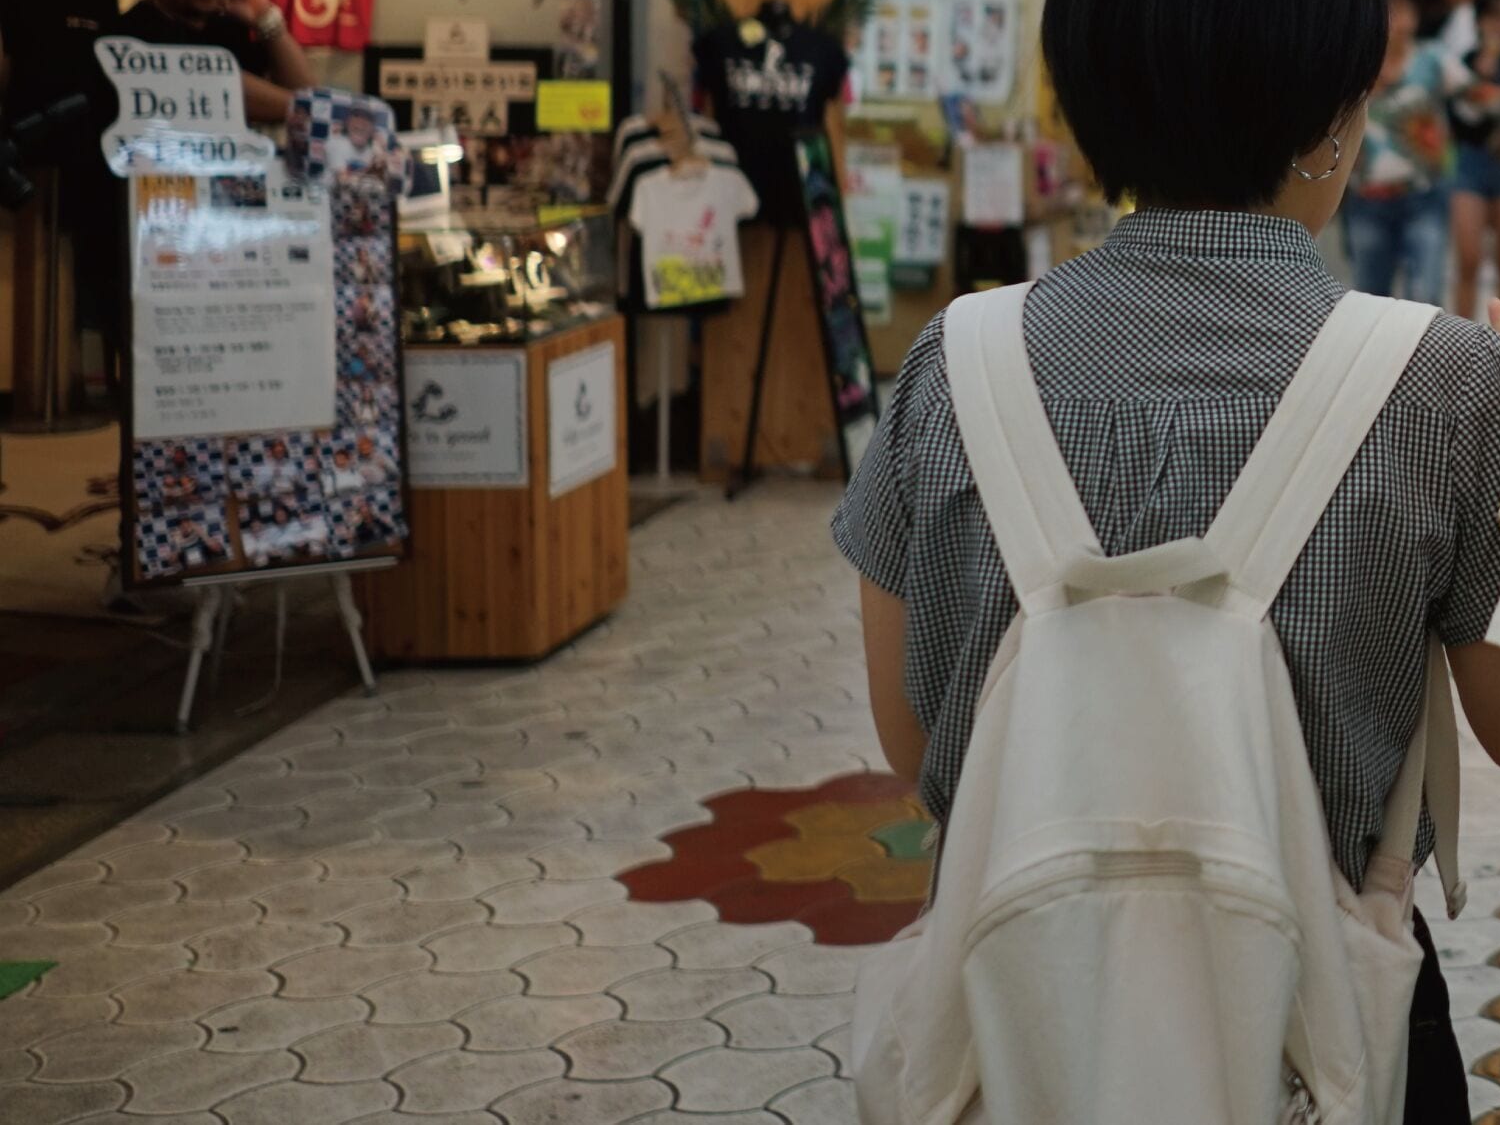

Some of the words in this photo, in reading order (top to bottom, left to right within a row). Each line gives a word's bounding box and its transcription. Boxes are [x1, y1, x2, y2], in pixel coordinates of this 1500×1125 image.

[106, 43, 169, 74] You
[179, 49, 234, 75] can
[130, 87, 177, 119] Do
[187, 88, 213, 120] it
